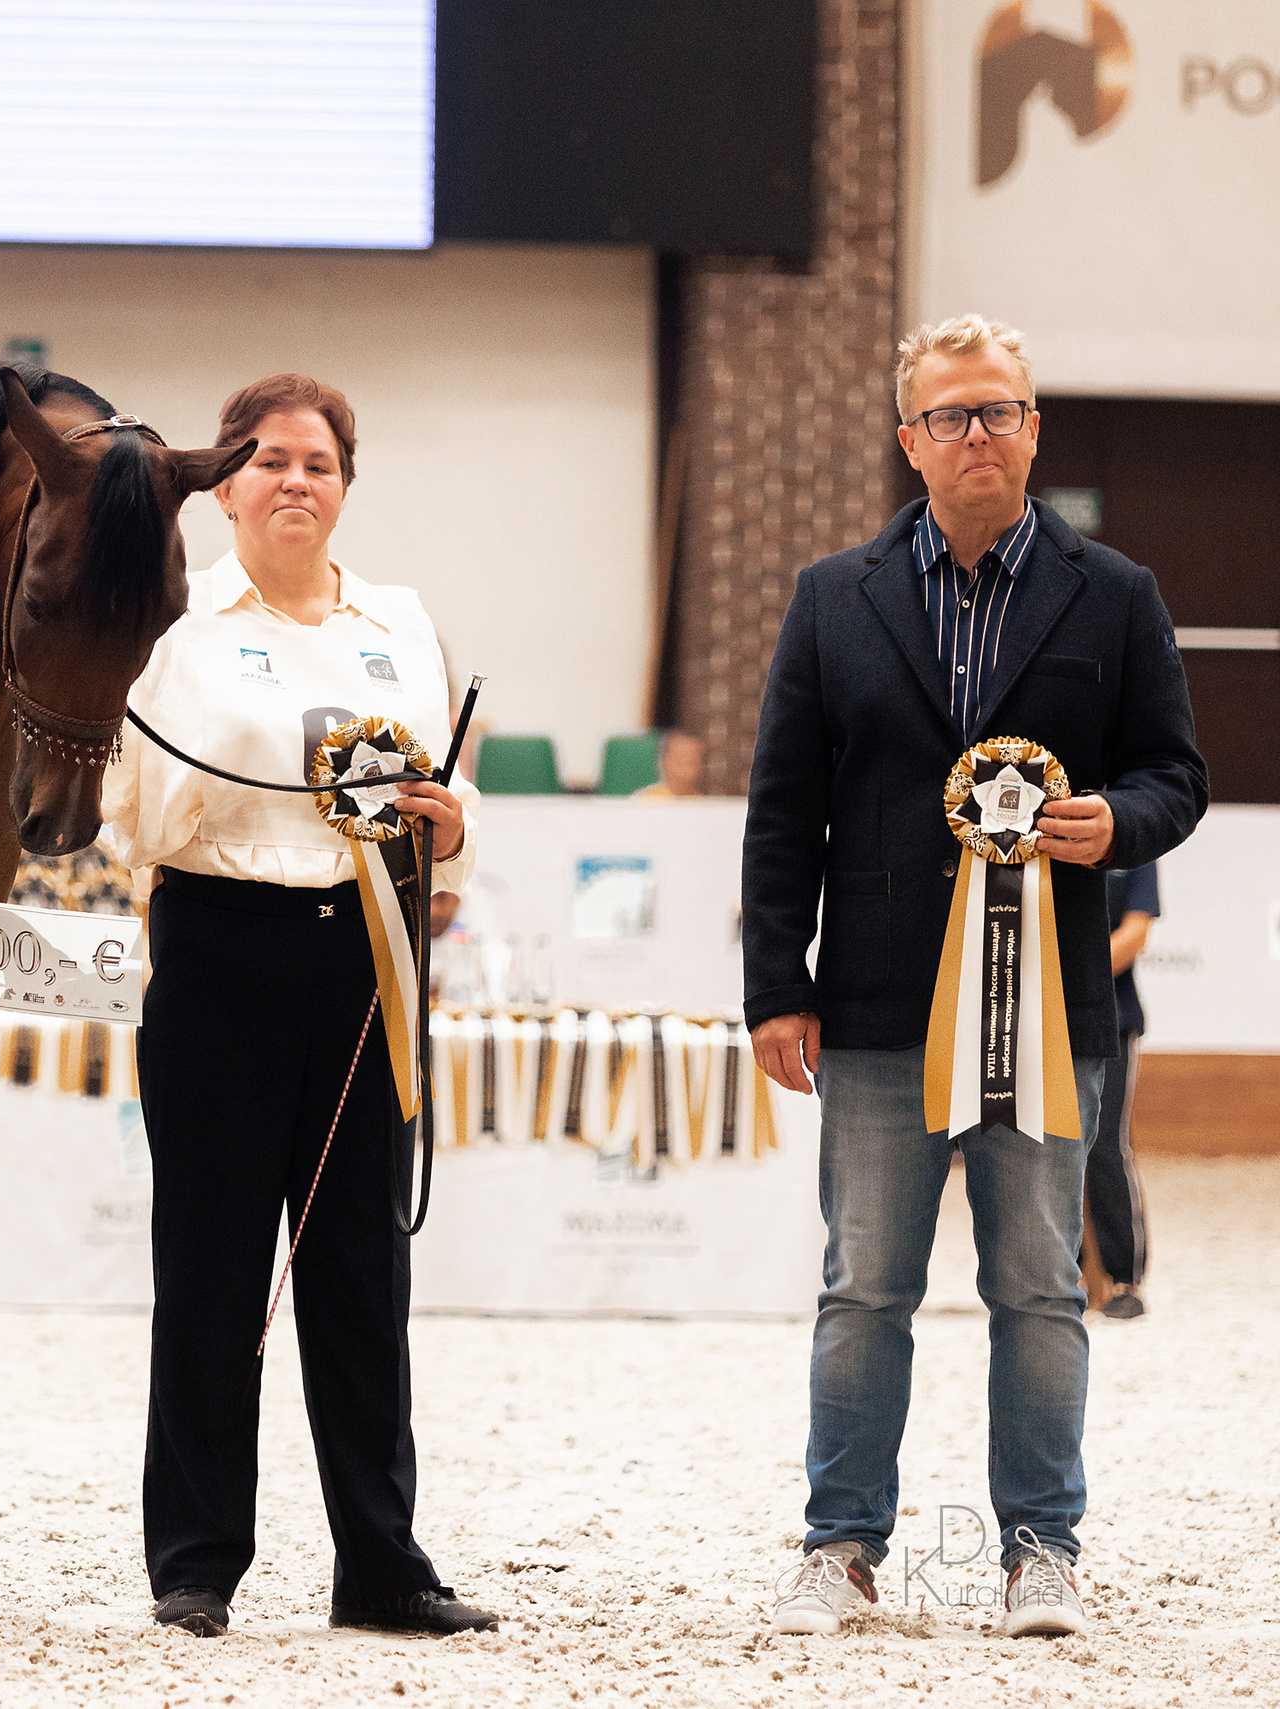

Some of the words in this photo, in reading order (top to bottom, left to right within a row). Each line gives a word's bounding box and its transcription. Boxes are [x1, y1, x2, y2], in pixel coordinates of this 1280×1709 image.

[92, 939, 126, 985] €
[990, 921, 1001, 963] лошадей
[1006, 929, 1016, 966] породы
[989, 964, 998, 998] России
[1004, 967, 1015, 1034] чистокровной
[988, 998, 998, 1051] Чемпионат
[987, 1052, 996, 1079] XVIII
[1002, 1034, 1012, 1078] арабской
